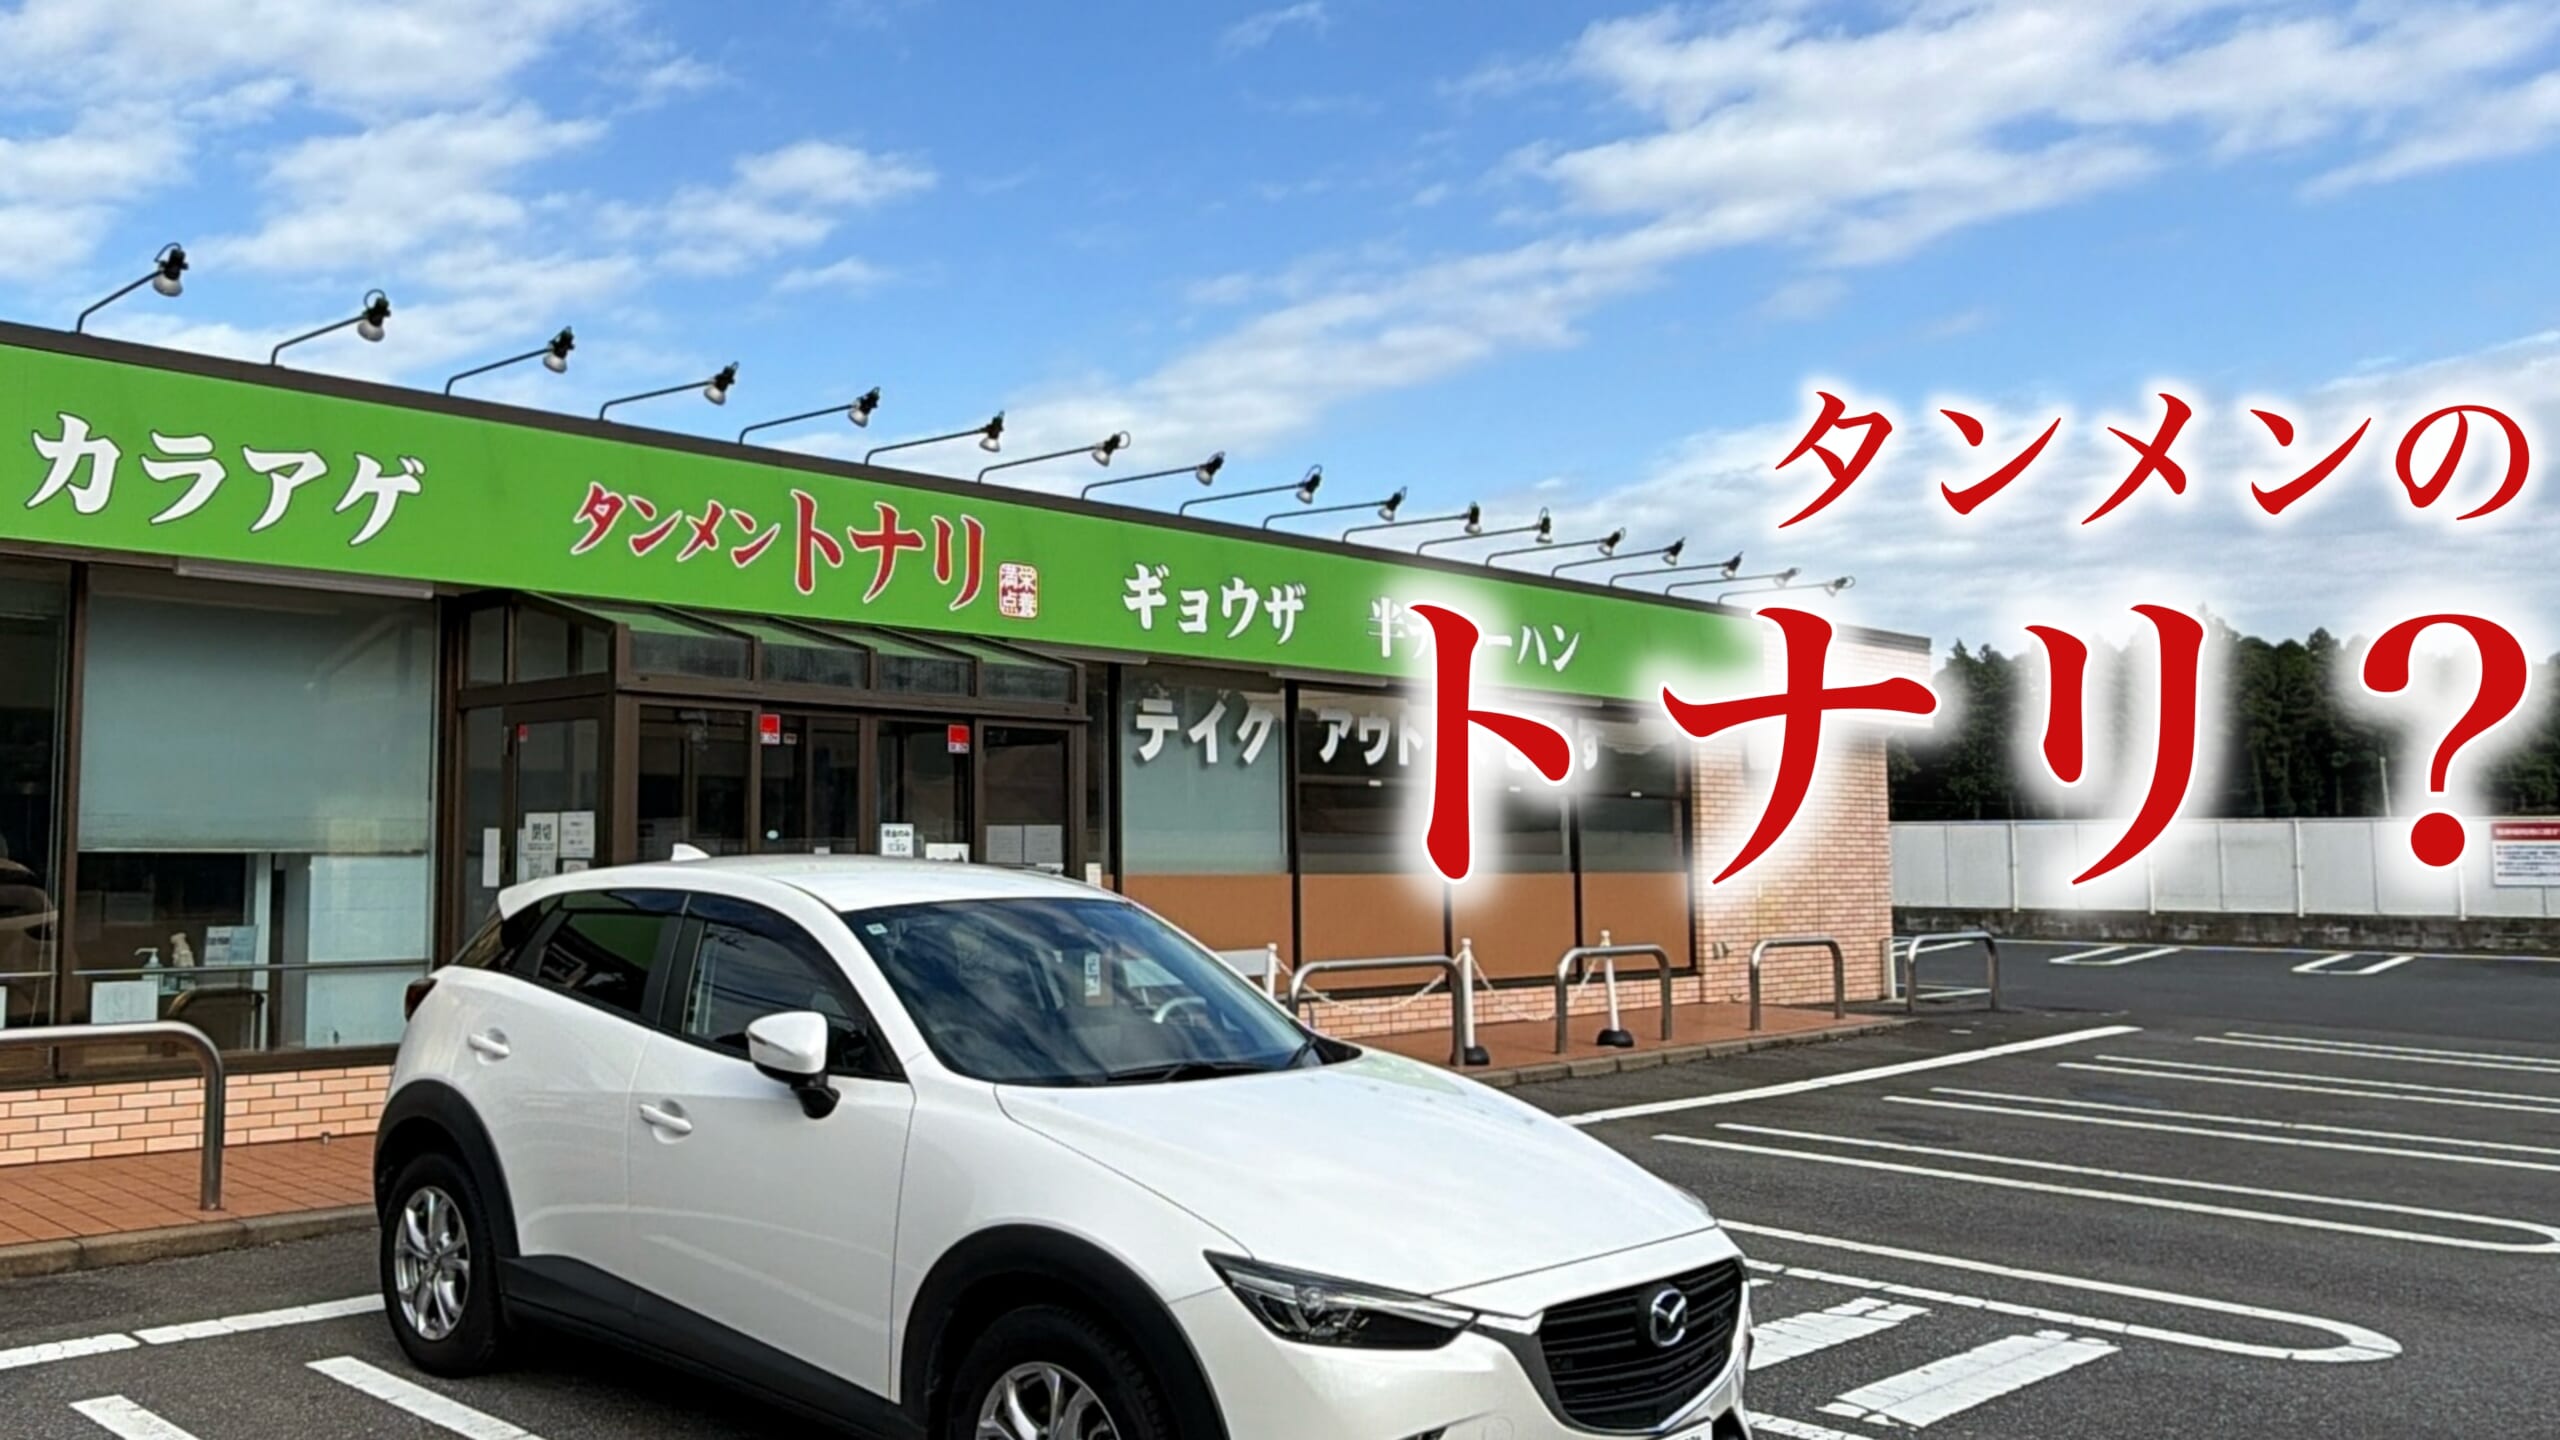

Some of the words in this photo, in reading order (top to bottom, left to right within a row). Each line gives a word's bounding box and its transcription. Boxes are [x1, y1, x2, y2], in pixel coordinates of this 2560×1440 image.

[26, 411, 427, 547] カラアゲ
[1122, 562, 1306, 646] ギョウザ
[1367, 597, 1580, 672] 半ーハン
[1136, 698, 1274, 765] テイク
[1319, 708, 1425, 767] アウト
